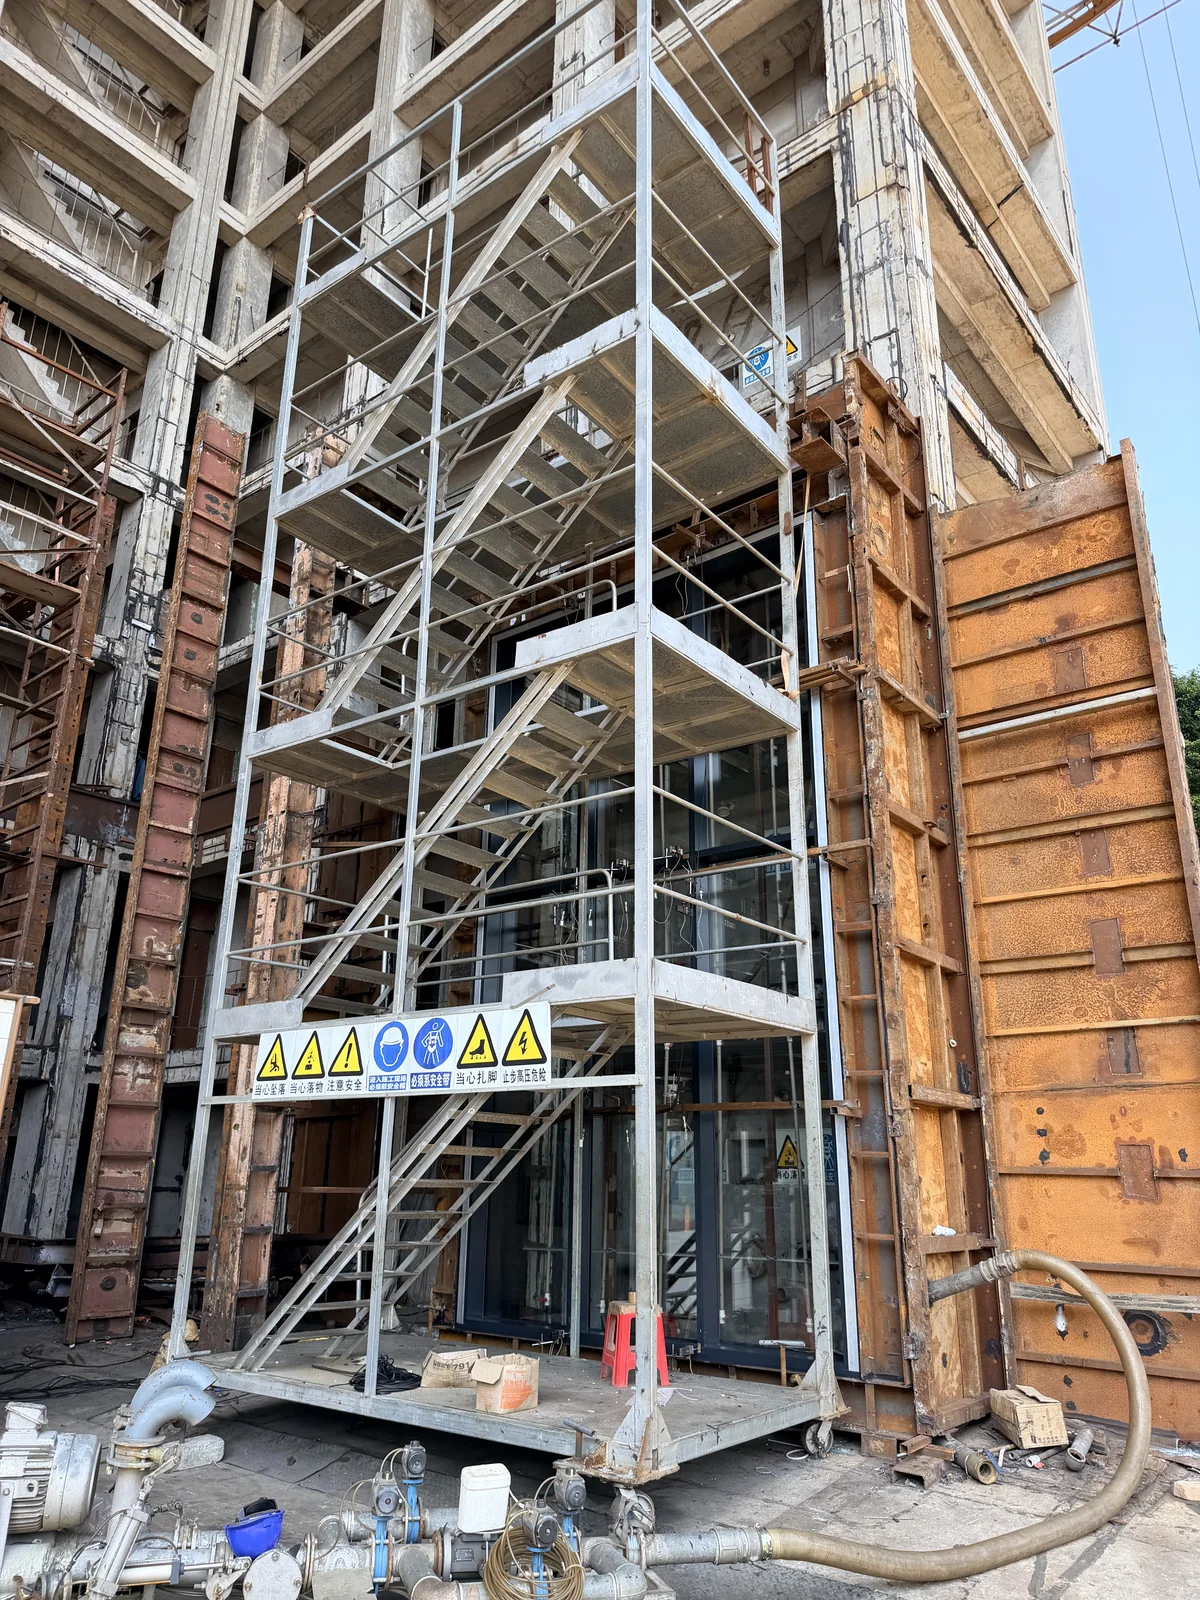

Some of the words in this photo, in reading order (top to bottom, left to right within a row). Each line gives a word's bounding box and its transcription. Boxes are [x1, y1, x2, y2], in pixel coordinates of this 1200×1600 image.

[411, 1073, 450, 1088] 必须系安全带
[456, 1070, 497, 1085] 当心扎脚
[503, 1067, 546, 1083] 止步高压危险
[254, 1083, 286, 1096] 当心坠落
[290, 1081, 323, 1094] 当心落物
[327, 1079, 362, 1092] 注意安全
[452, 1361, 469, 1371] 791
